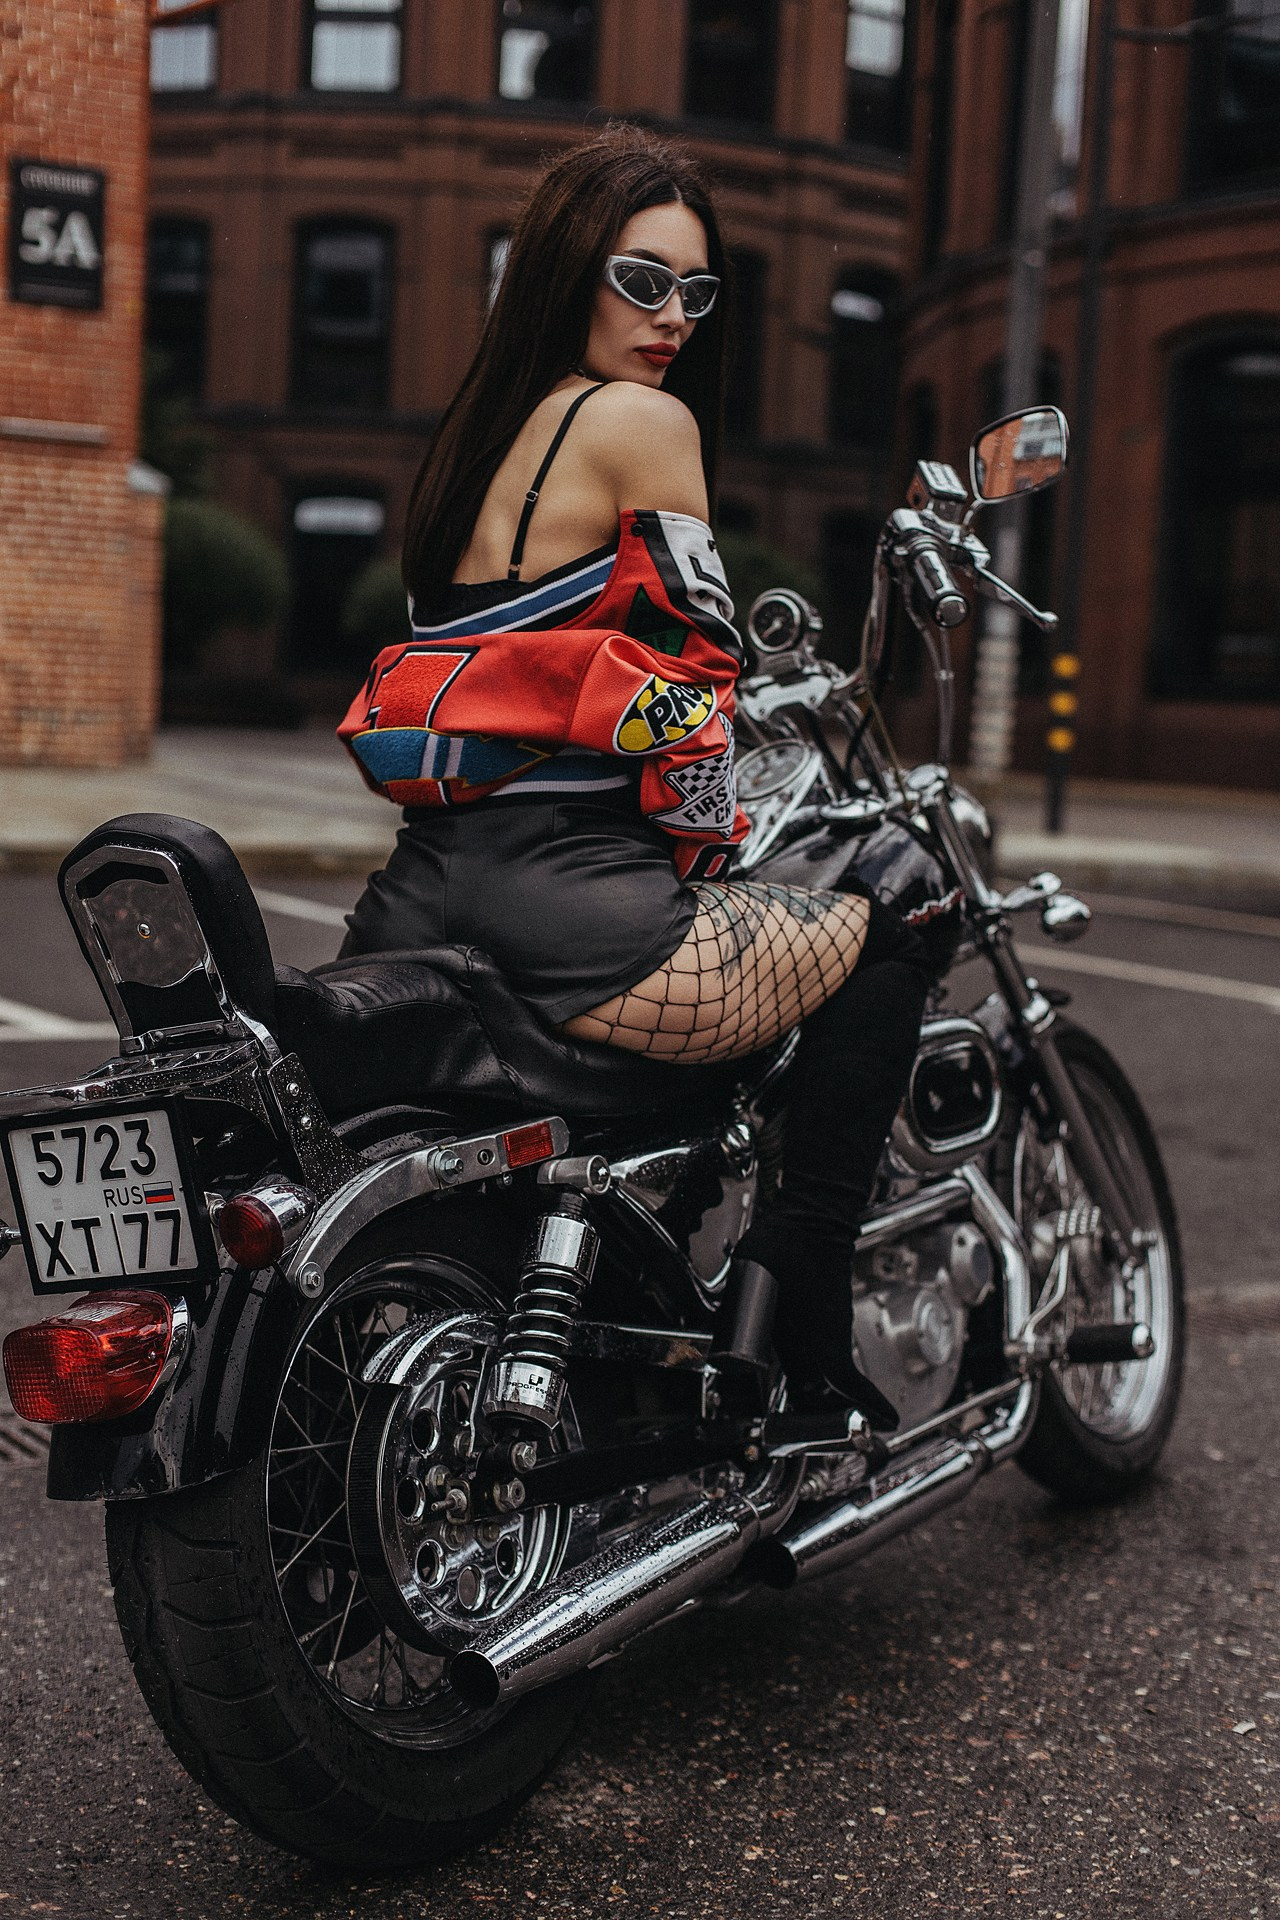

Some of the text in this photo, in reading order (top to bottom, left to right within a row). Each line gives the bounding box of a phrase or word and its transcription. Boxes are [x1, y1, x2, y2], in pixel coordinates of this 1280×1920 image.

[19, 207, 100, 270] 5A
[683, 786, 730, 825] FIRS
[31, 1119, 157, 1187] 5723
[103, 1186, 144, 1208] RUS
[35, 1209, 181, 1277] XT 77
